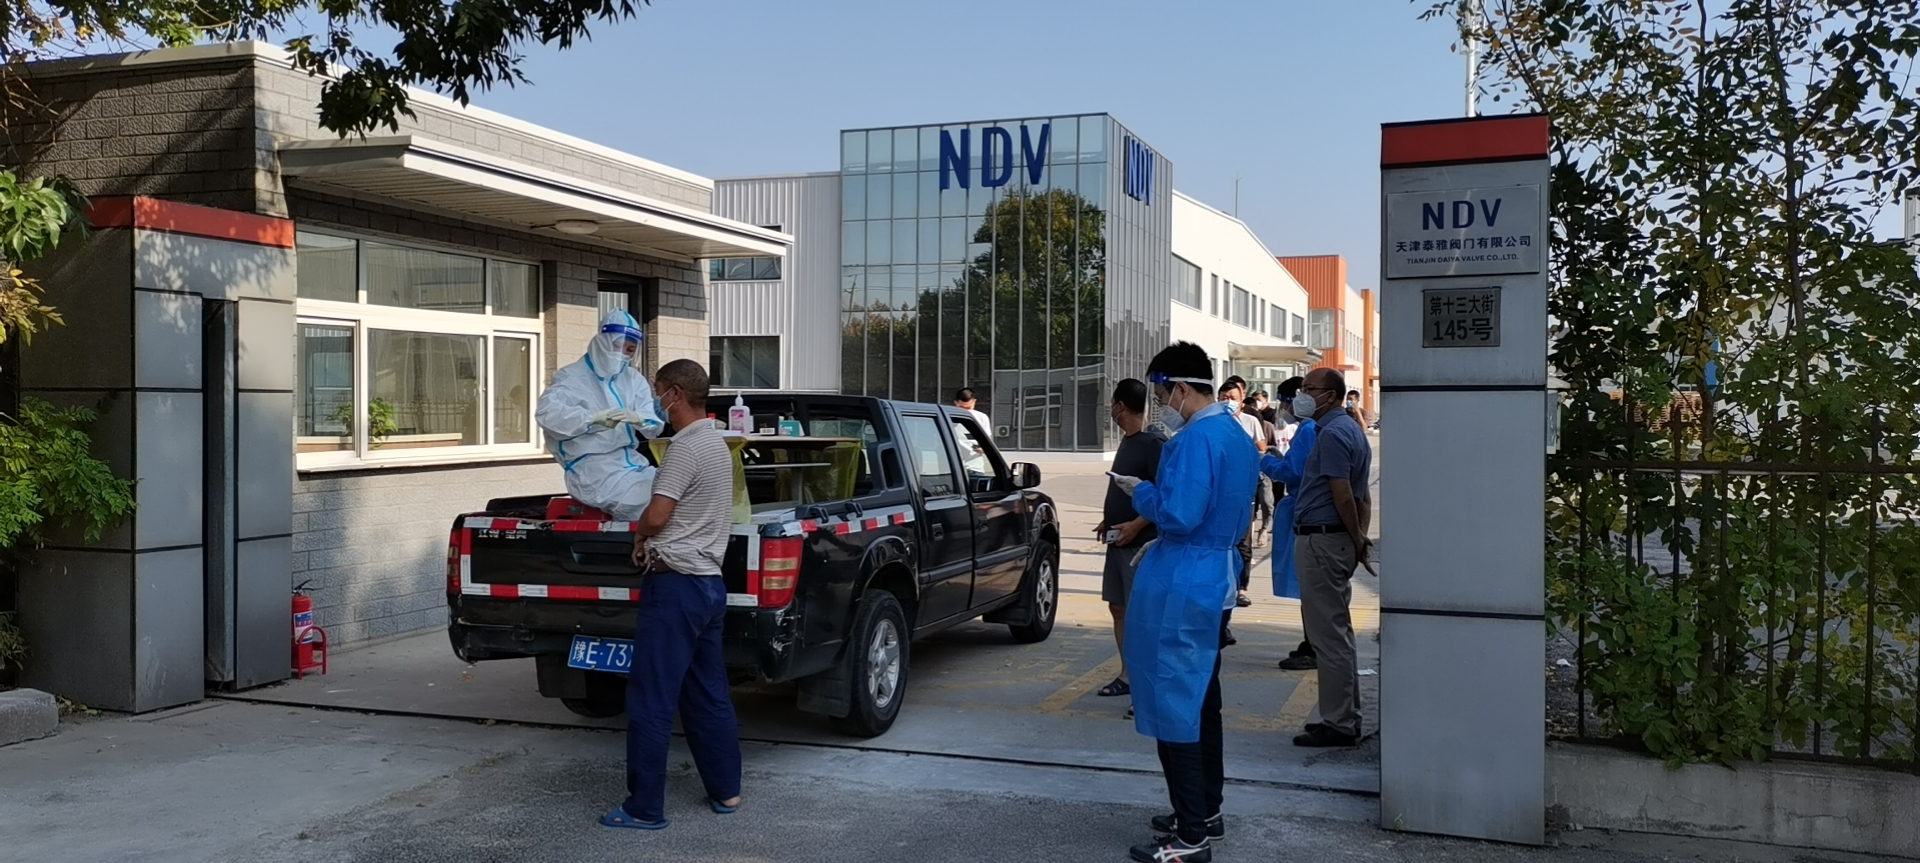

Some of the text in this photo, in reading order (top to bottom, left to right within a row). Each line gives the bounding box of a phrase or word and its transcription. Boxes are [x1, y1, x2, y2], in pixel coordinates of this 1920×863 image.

[939, 123, 1050, 190] NDV
[1123, 136, 1154, 206] NDV
[1422, 198, 1502, 231] NDV
[1396, 235, 1531, 253] 天津泰雅阀门有限公司
[1406, 257, 1436, 265] TIANJIN
[1437, 255, 1460, 264] DAIYA
[1461, 254, 1485, 262] VALVE
[1430, 294, 1494, 316] 第十三大街
[1433, 318, 1494, 341] 145号
